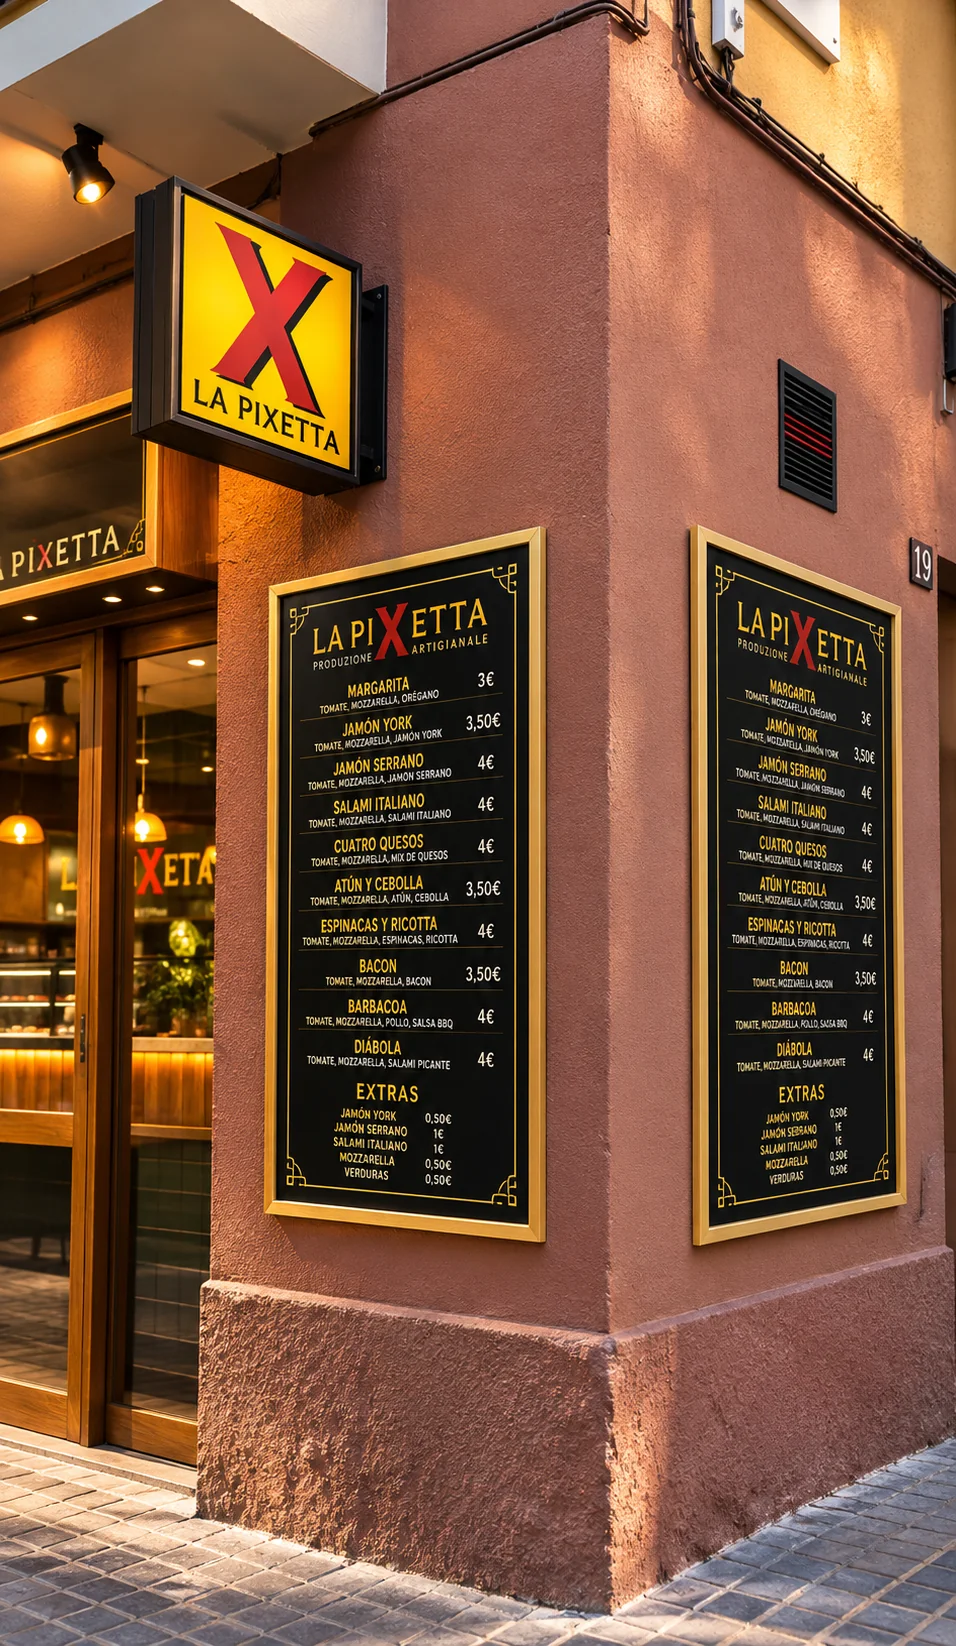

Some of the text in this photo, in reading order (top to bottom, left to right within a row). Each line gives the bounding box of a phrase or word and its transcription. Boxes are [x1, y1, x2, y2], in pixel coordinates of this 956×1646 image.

[210, 222, 333, 418] X
[194, 378, 340, 455] LA PIXETTA
[12, 525, 119, 577] PIXETTA
[914, 546, 931, 581] 19
[738, 601, 765, 638] LA
[313, 625, 344, 655] LA
[314, 634, 487, 670] PRODUZIONE ARTIGIANALE
[738, 638, 867, 686] PRODUZIONE ARTIGIANALE
[478, 672, 494, 687] 3€
[348, 677, 409, 698] MARGARITA
[770, 679, 815, 704] MARGARITA
[343, 715, 412, 736] JAMÓN YORK
[467, 713, 500, 731] 3,50€
[862, 711, 871, 726] 3€
[766, 718, 817, 742] JAMÓN YORK
[478, 755, 494, 769] 4€
[854, 747, 875, 764] 3,50€
[334, 753, 423, 776] JAMÓN SERRANO
[758, 756, 826, 782] JAMÓN SERRANO
[862, 786, 872, 799] 4€
[334, 793, 424, 814] SALAMI ITALIANO
[478, 797, 494, 811] 4€
[759, 795, 826, 819] SALAMI ITALIANO
[862, 822, 872, 836] 4€
[334, 834, 423, 853] CUATRO QUESOS
[478, 839, 494, 853] 4€
[760, 836, 826, 858] CUATRO QUESOS
[862, 859, 872, 873] 4€
[335, 875, 423, 892] ATÚN Y CEBOLLA
[467, 881, 500, 898] 3,50€
[760, 876, 826, 896] ATÚN Y CEBOLLA
[855, 895, 875, 910] 3,50€
[322, 916, 437, 933] ESPINACAS Y RICOTTA
[478, 924, 494, 938] 4€
[748, 917, 836, 936] ESPINACAS Y RICOTTA
[863, 934, 872, 947] 4€
[360, 959, 396, 973] BACON
[781, 961, 808, 975] BACON
[466, 967, 500, 983] 3,50€
[856, 971, 876, 986] 3,50€
[349, 999, 407, 1014] BARBACOA
[772, 1002, 816, 1015] BARBACOA
[478, 1009, 494, 1024] 4€
[863, 1010, 873, 1023] 4€
[355, 1036, 401, 1055] DIÁBOLA
[777, 1039, 812, 1056] DIÁBOLA
[478, 1052, 493, 1067] 4€
[863, 1048, 873, 1061] 4€
[357, 1083, 418, 1102] EXTRAS
[780, 1084, 824, 1103] EXTRAS
[341, 1107, 396, 1121] JAMÓN YORK
[425, 1113, 451, 1124] 0,50€
[767, 1111, 789, 1124] JAMÓN
[830, 1107, 847, 1118] 0,50€
[334, 1121, 407, 1136] JAMÓN SERRANO
[434, 1129, 443, 1139] 1€
[761, 1127, 786, 1140] JAMÓN
[835, 1122, 841, 1131] 1€
[334, 1137, 407, 1151] SALAMI ITALIANO
[835, 1136, 841, 1145] 1€
[434, 1144, 443, 1154] 1€
[760, 1143, 785, 1155] SALAMI
[830, 1150, 847, 1161] 0,50€
[340, 1152, 394, 1166] MOZZARELLA
[425, 1159, 451, 1170] 0,50€
[766, 1156, 808, 1169] MOZZARELLA
[345, 1168, 388, 1180] VERDURAS
[830, 1164, 847, 1175] 0,50€
[426, 1174, 451, 1185] 0,50€
